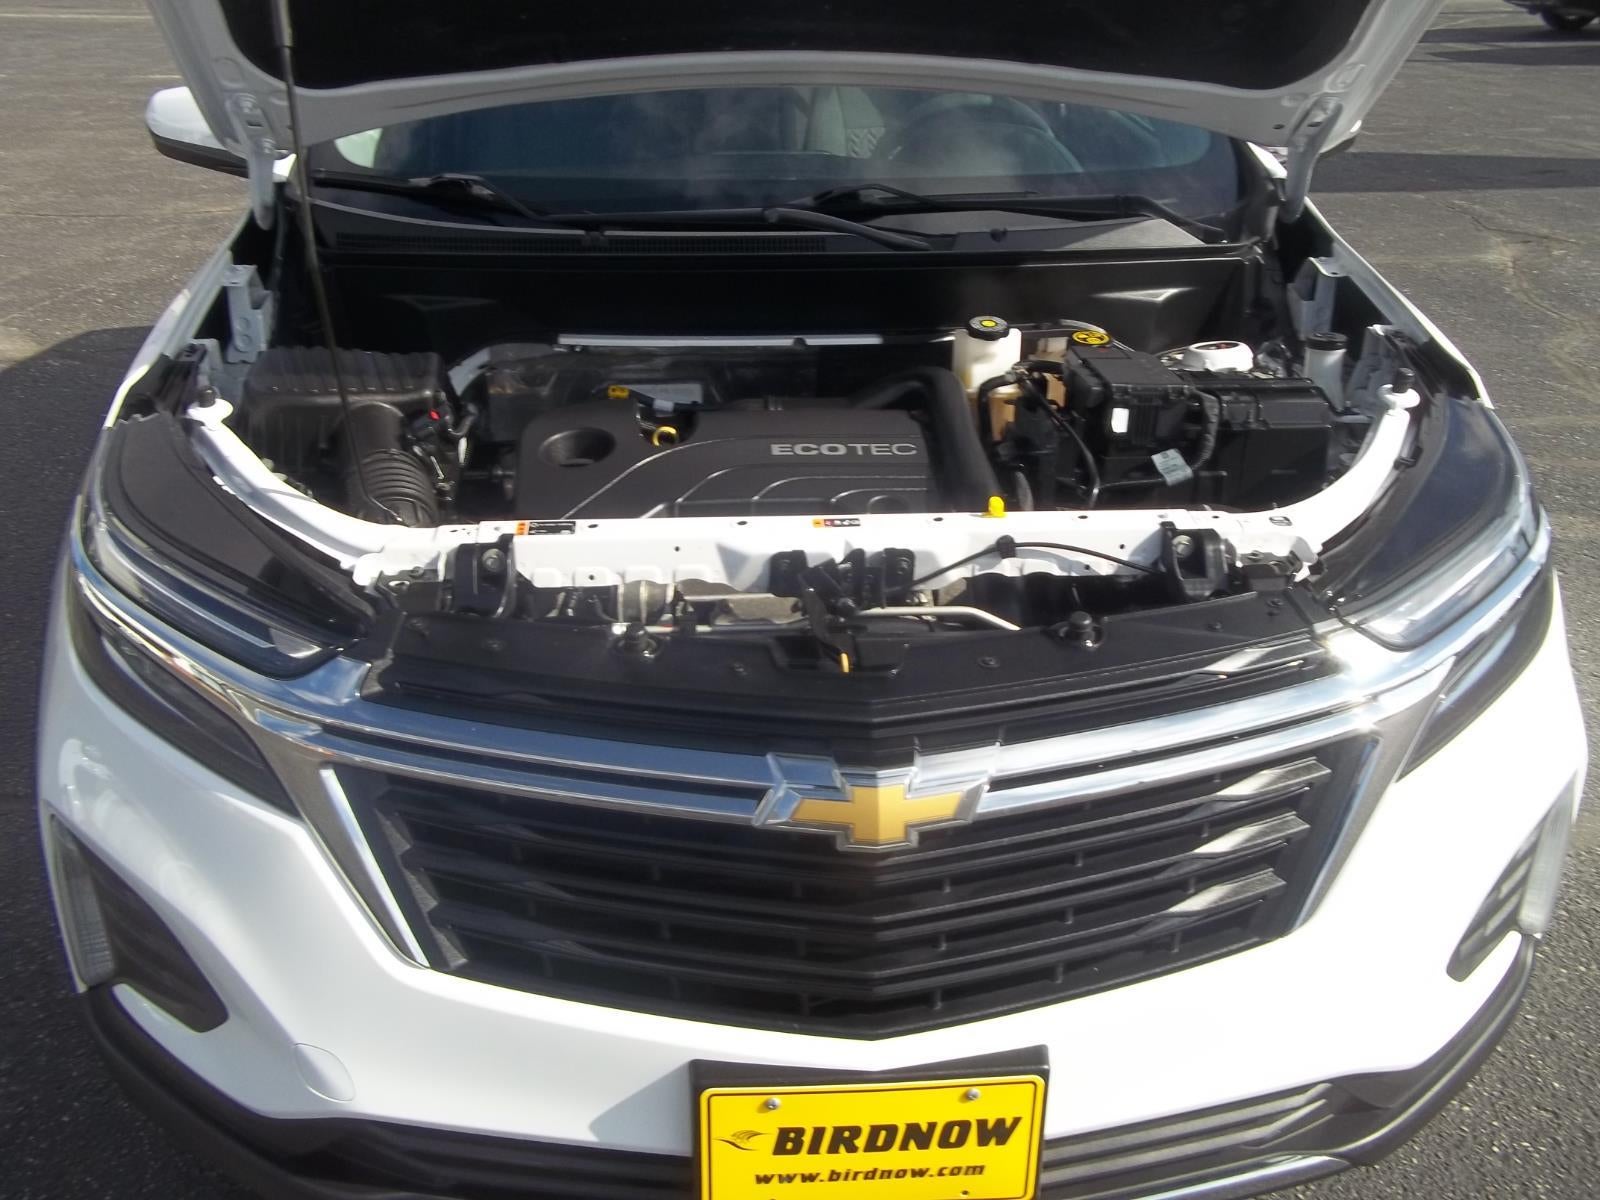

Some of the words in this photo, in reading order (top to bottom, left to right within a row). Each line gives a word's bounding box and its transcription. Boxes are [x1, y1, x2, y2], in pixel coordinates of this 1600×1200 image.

[770, 443, 917, 456] ECOTEC
[772, 1116, 1023, 1156] BIRDNOW
[755, 1164, 985, 1185] www.birdnow.com
